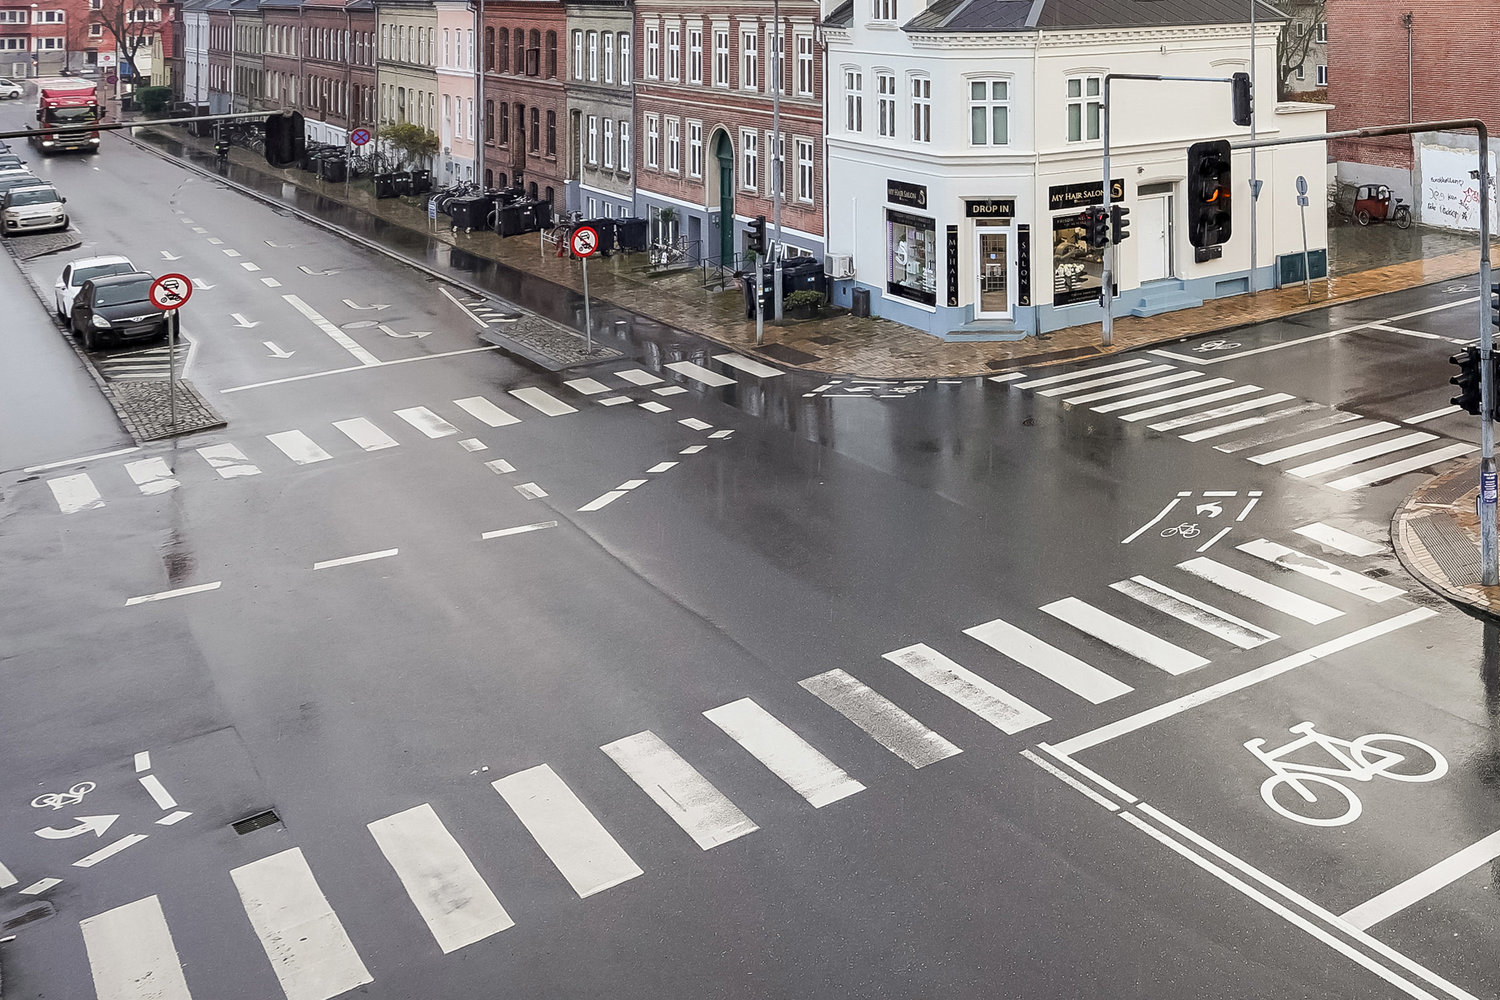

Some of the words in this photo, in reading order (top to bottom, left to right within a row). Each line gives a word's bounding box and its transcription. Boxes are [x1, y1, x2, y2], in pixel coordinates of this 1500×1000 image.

[1051, 194, 1064, 202] MY
[1065, 192, 1083, 200] HAIR
[1083, 189, 1104, 199] SALON
[972, 204, 998, 213] DROP
[999, 204, 1010, 213] IN
